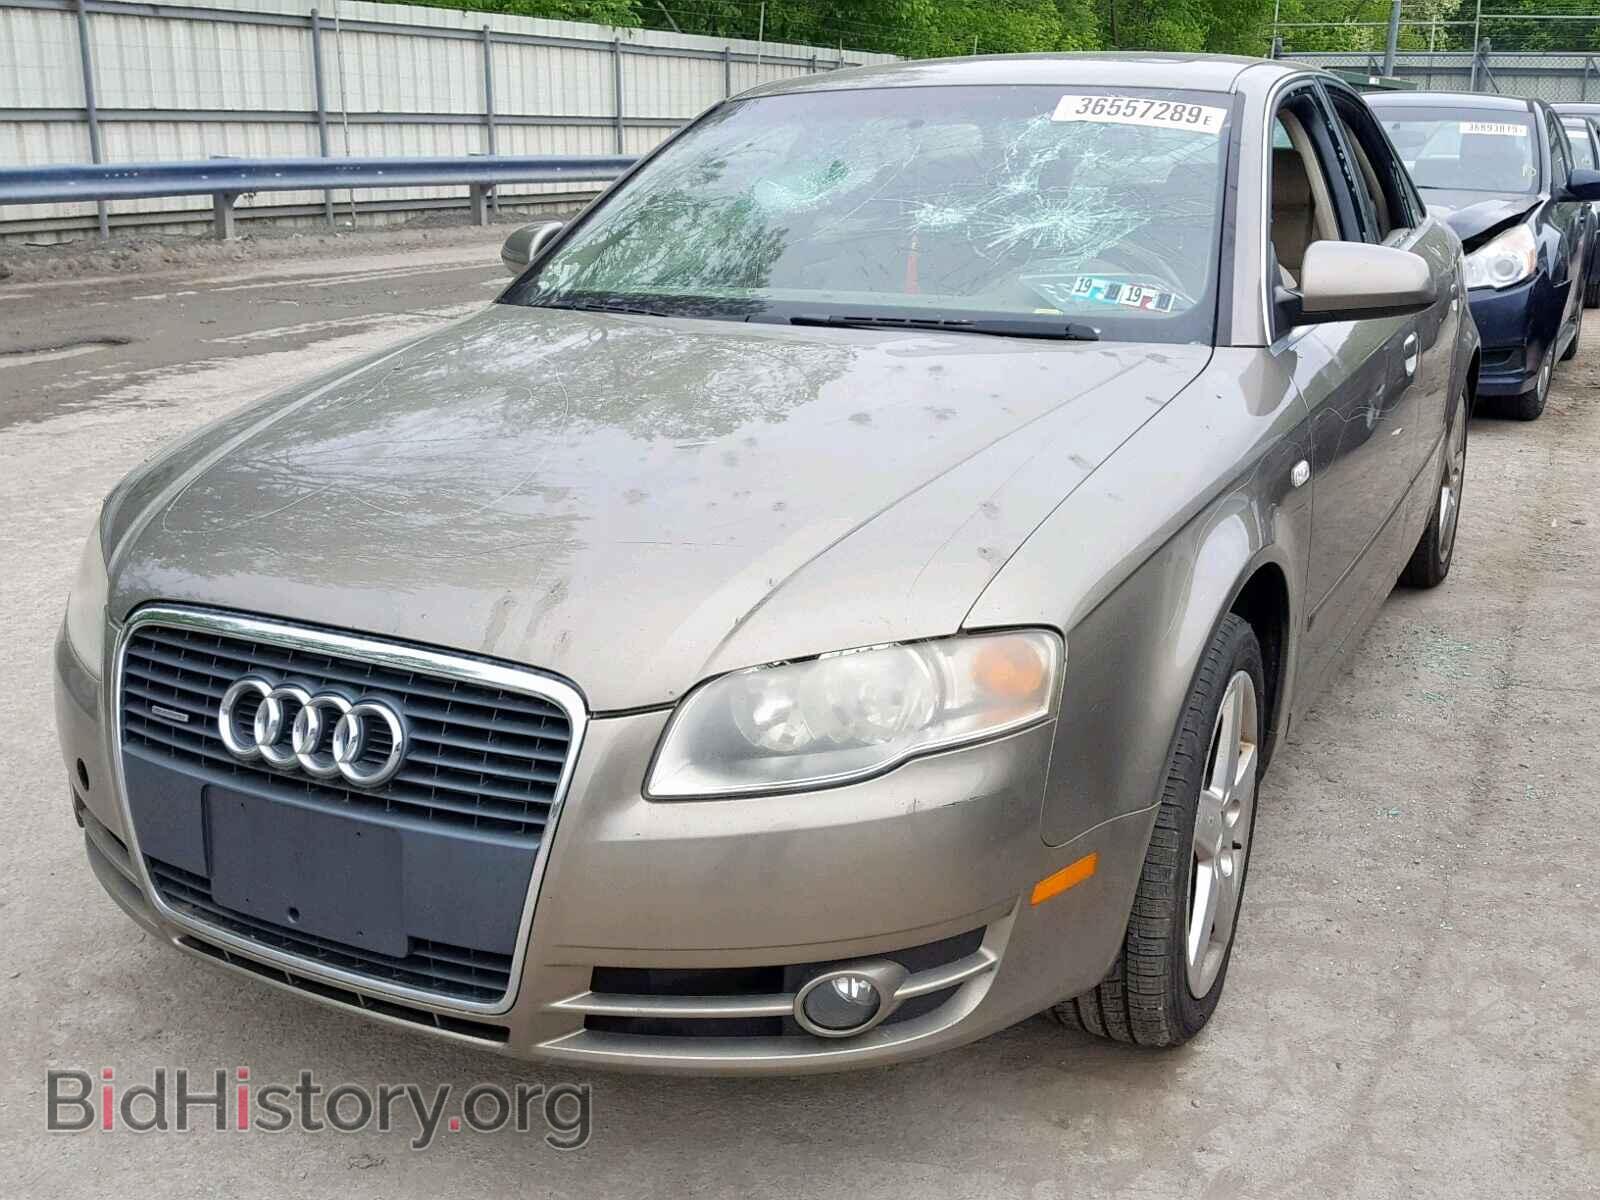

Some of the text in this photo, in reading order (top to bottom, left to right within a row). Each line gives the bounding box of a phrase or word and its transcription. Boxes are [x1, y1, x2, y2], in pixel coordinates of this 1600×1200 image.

[1075, 97, 1213, 126] 36557289 E
[1075, 278, 1092, 293] 19
[1126, 287, 1142, 302] 19
